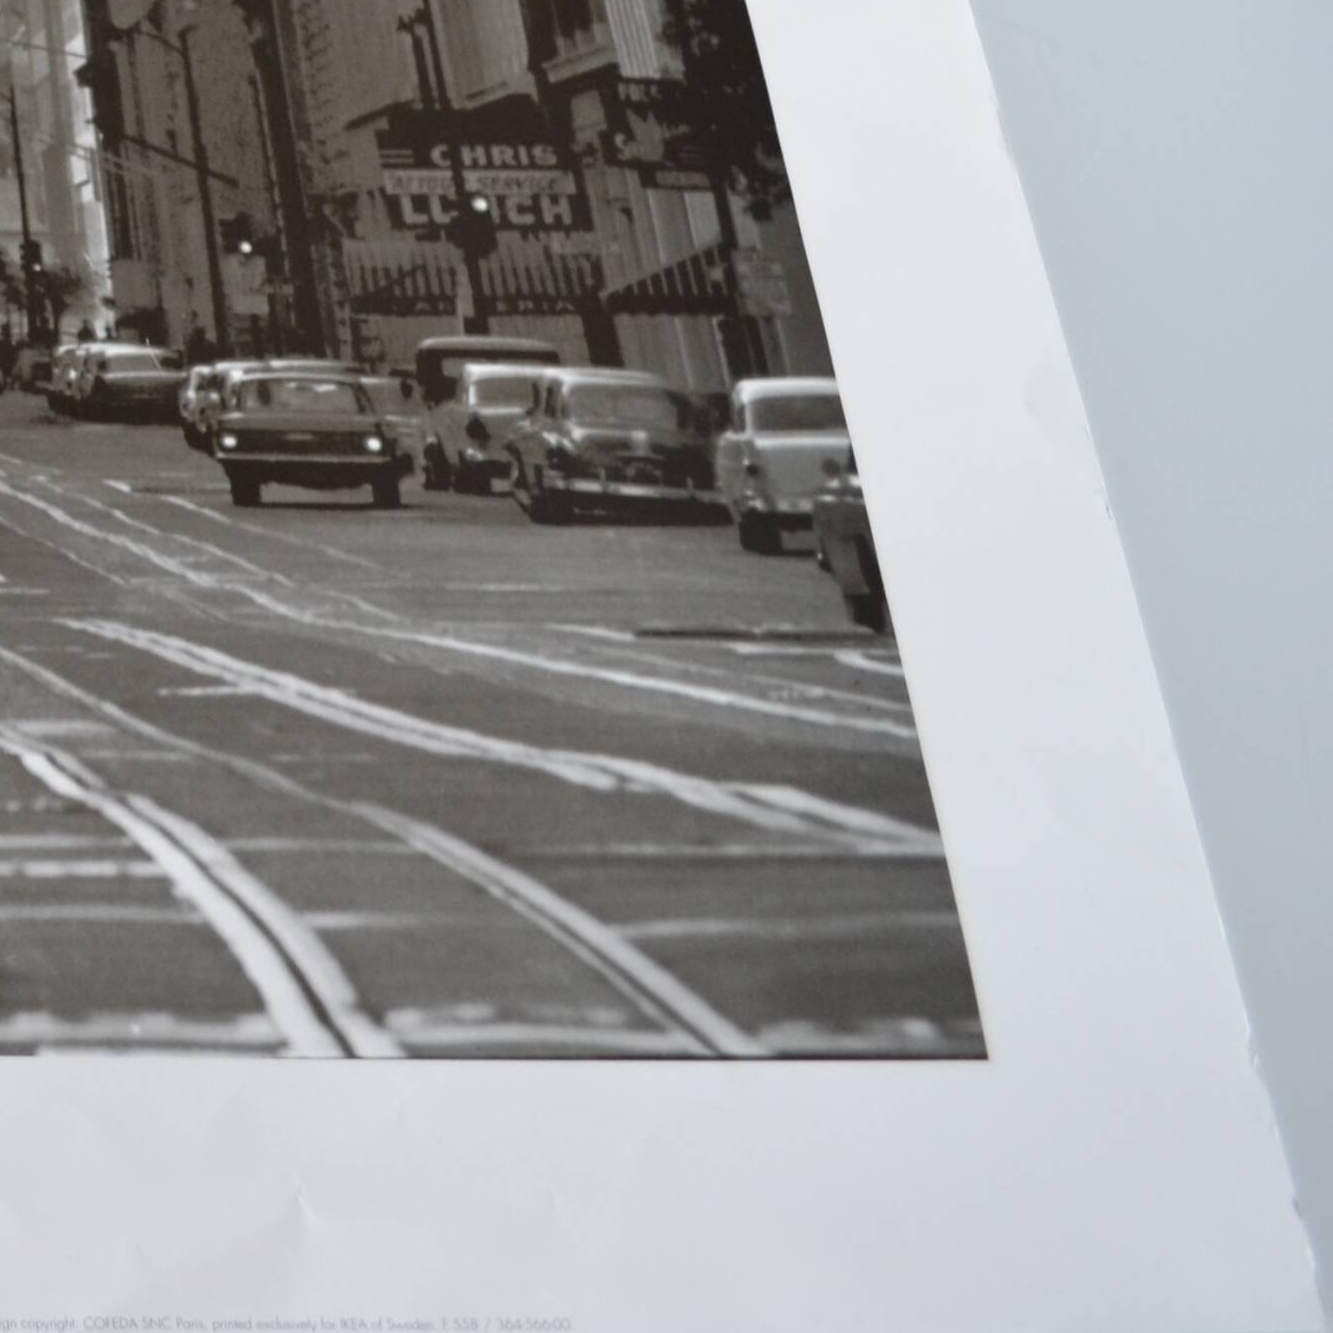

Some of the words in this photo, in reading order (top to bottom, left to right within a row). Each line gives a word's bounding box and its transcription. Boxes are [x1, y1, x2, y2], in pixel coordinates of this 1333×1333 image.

[429, 144, 558, 167] CHRIS
[212, 1316, 252, 1333] printed
[255, 1316, 317, 1333] exclusively
[320, 1317, 335, 1331] for
[340, 1317, 368, 1331] IKEA
